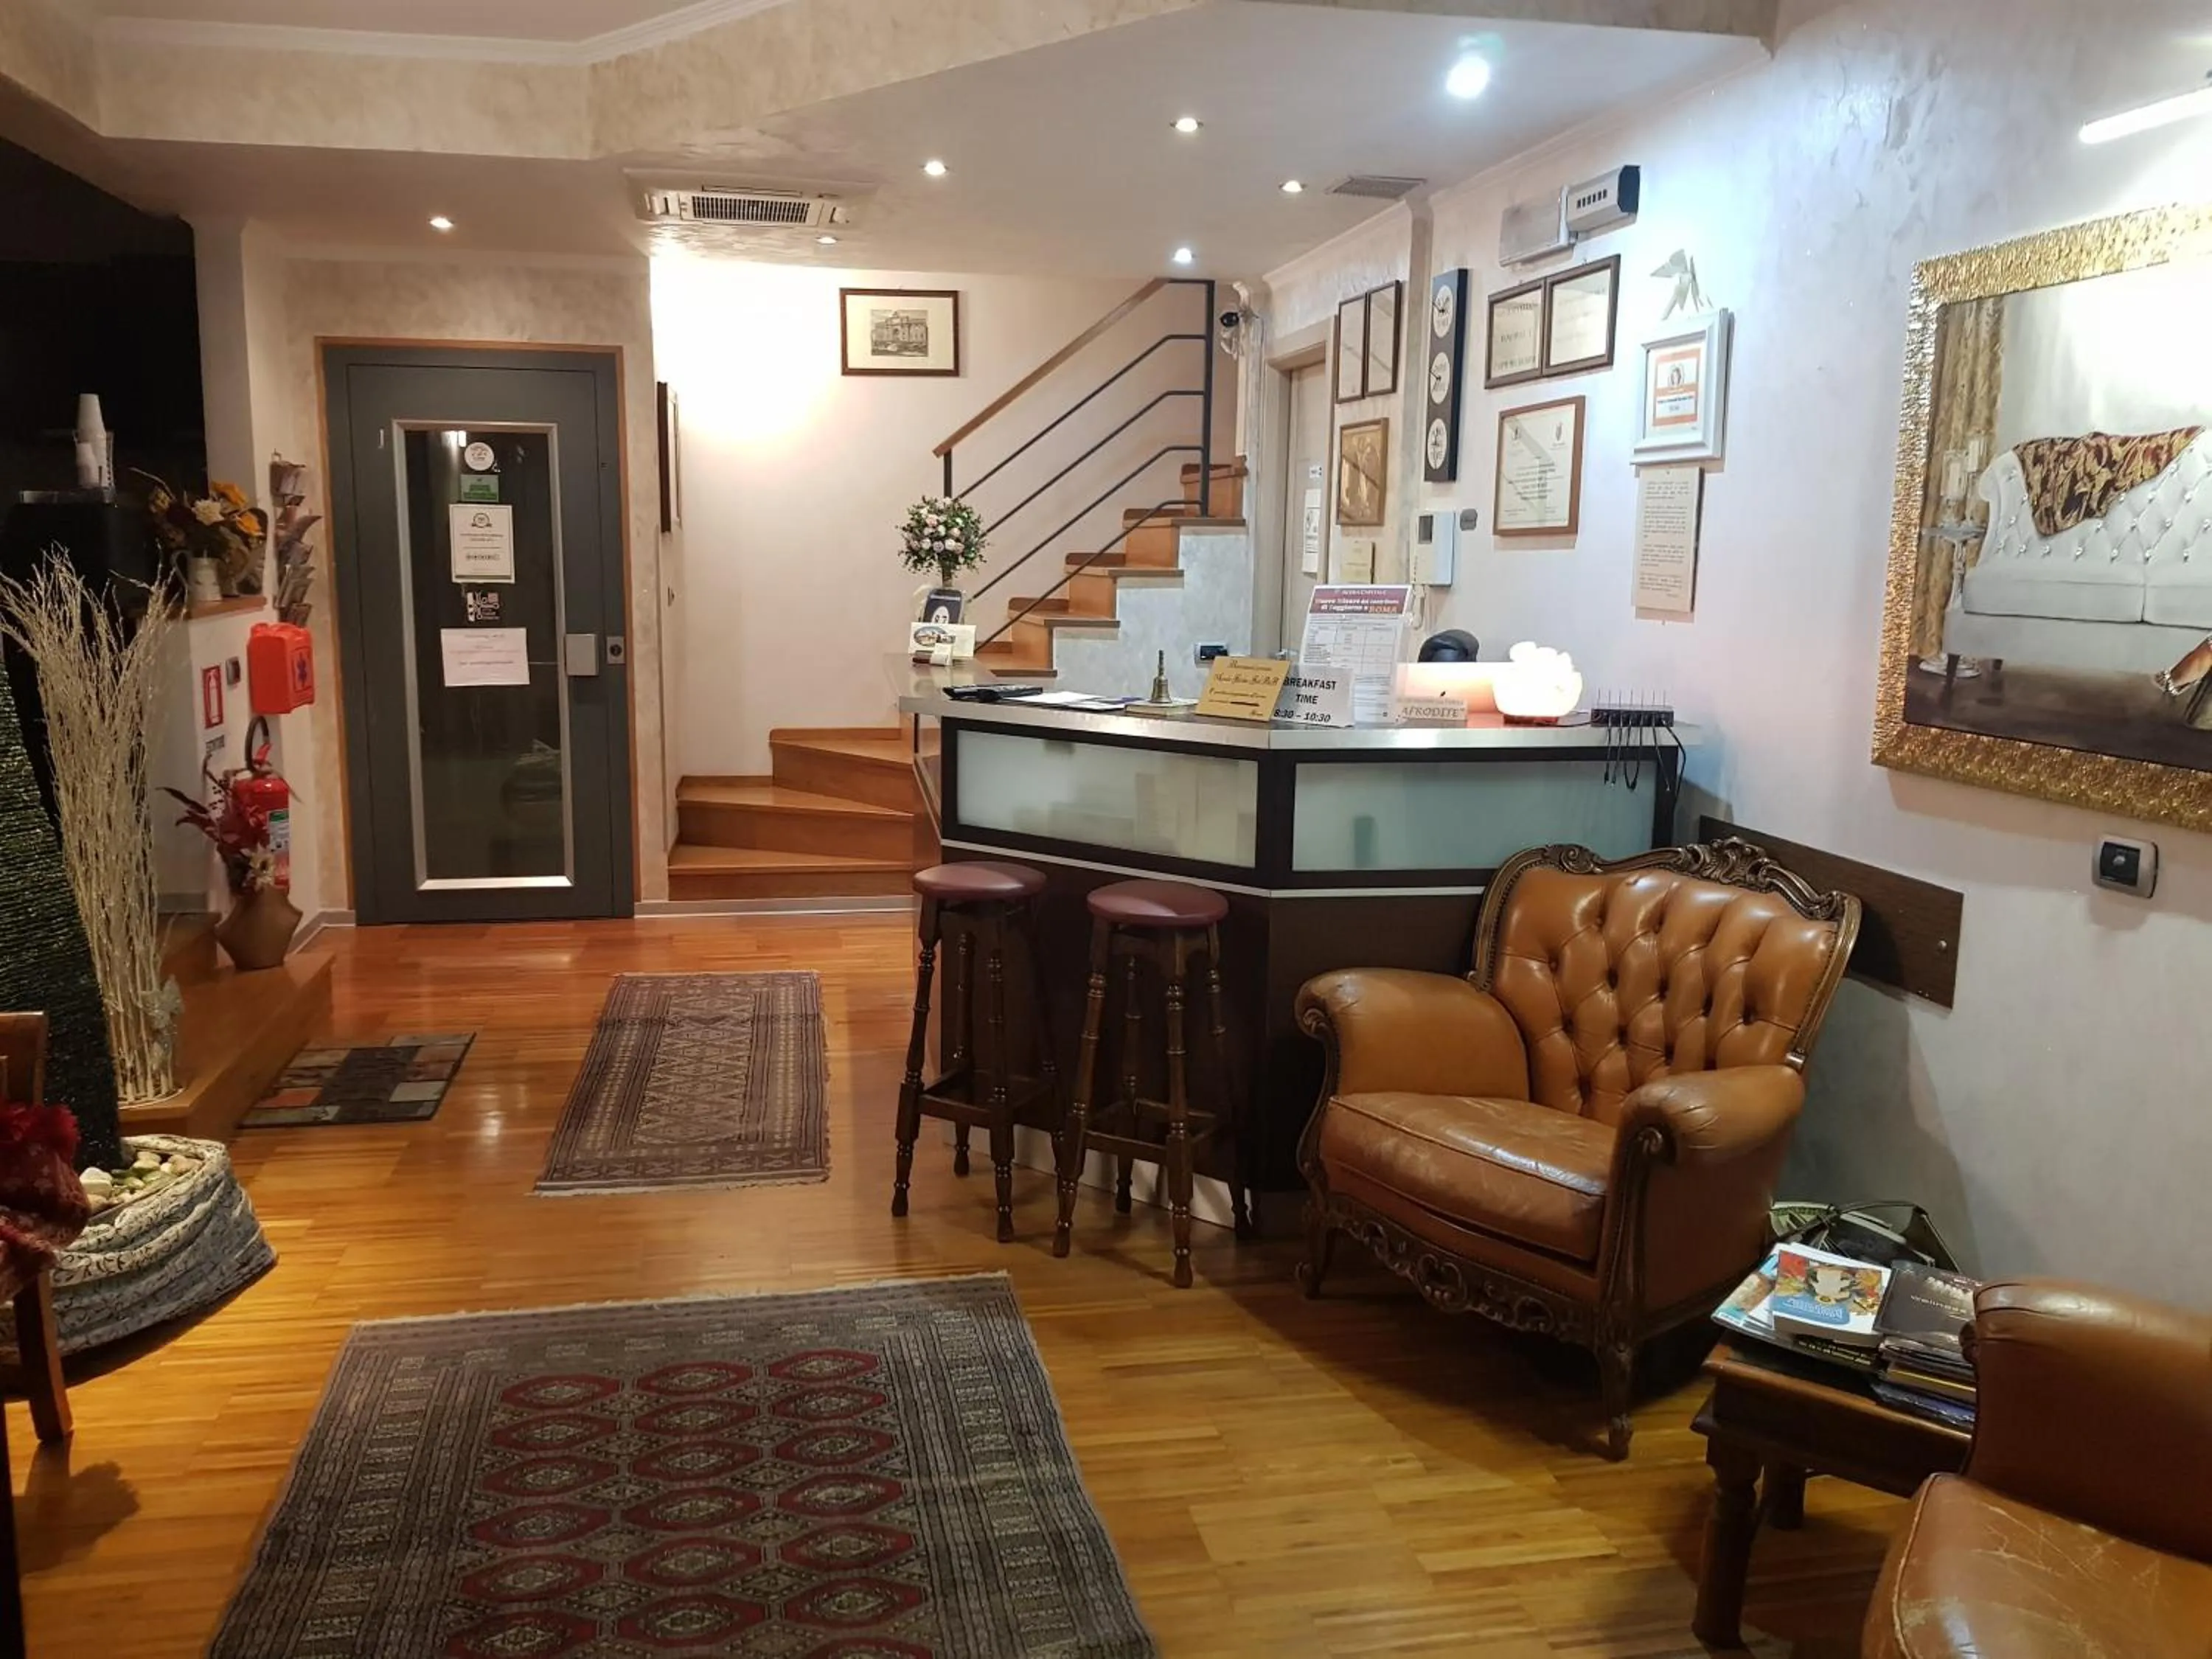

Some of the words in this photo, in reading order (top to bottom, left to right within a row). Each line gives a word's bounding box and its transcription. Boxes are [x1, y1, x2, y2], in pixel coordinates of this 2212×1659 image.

[1368, 605, 1398, 613] ROMA
[1283, 676, 1337, 690] BREAKFAST
[1296, 694, 1319, 704] TIME
[1304, 712, 1331, 723] 10:30
